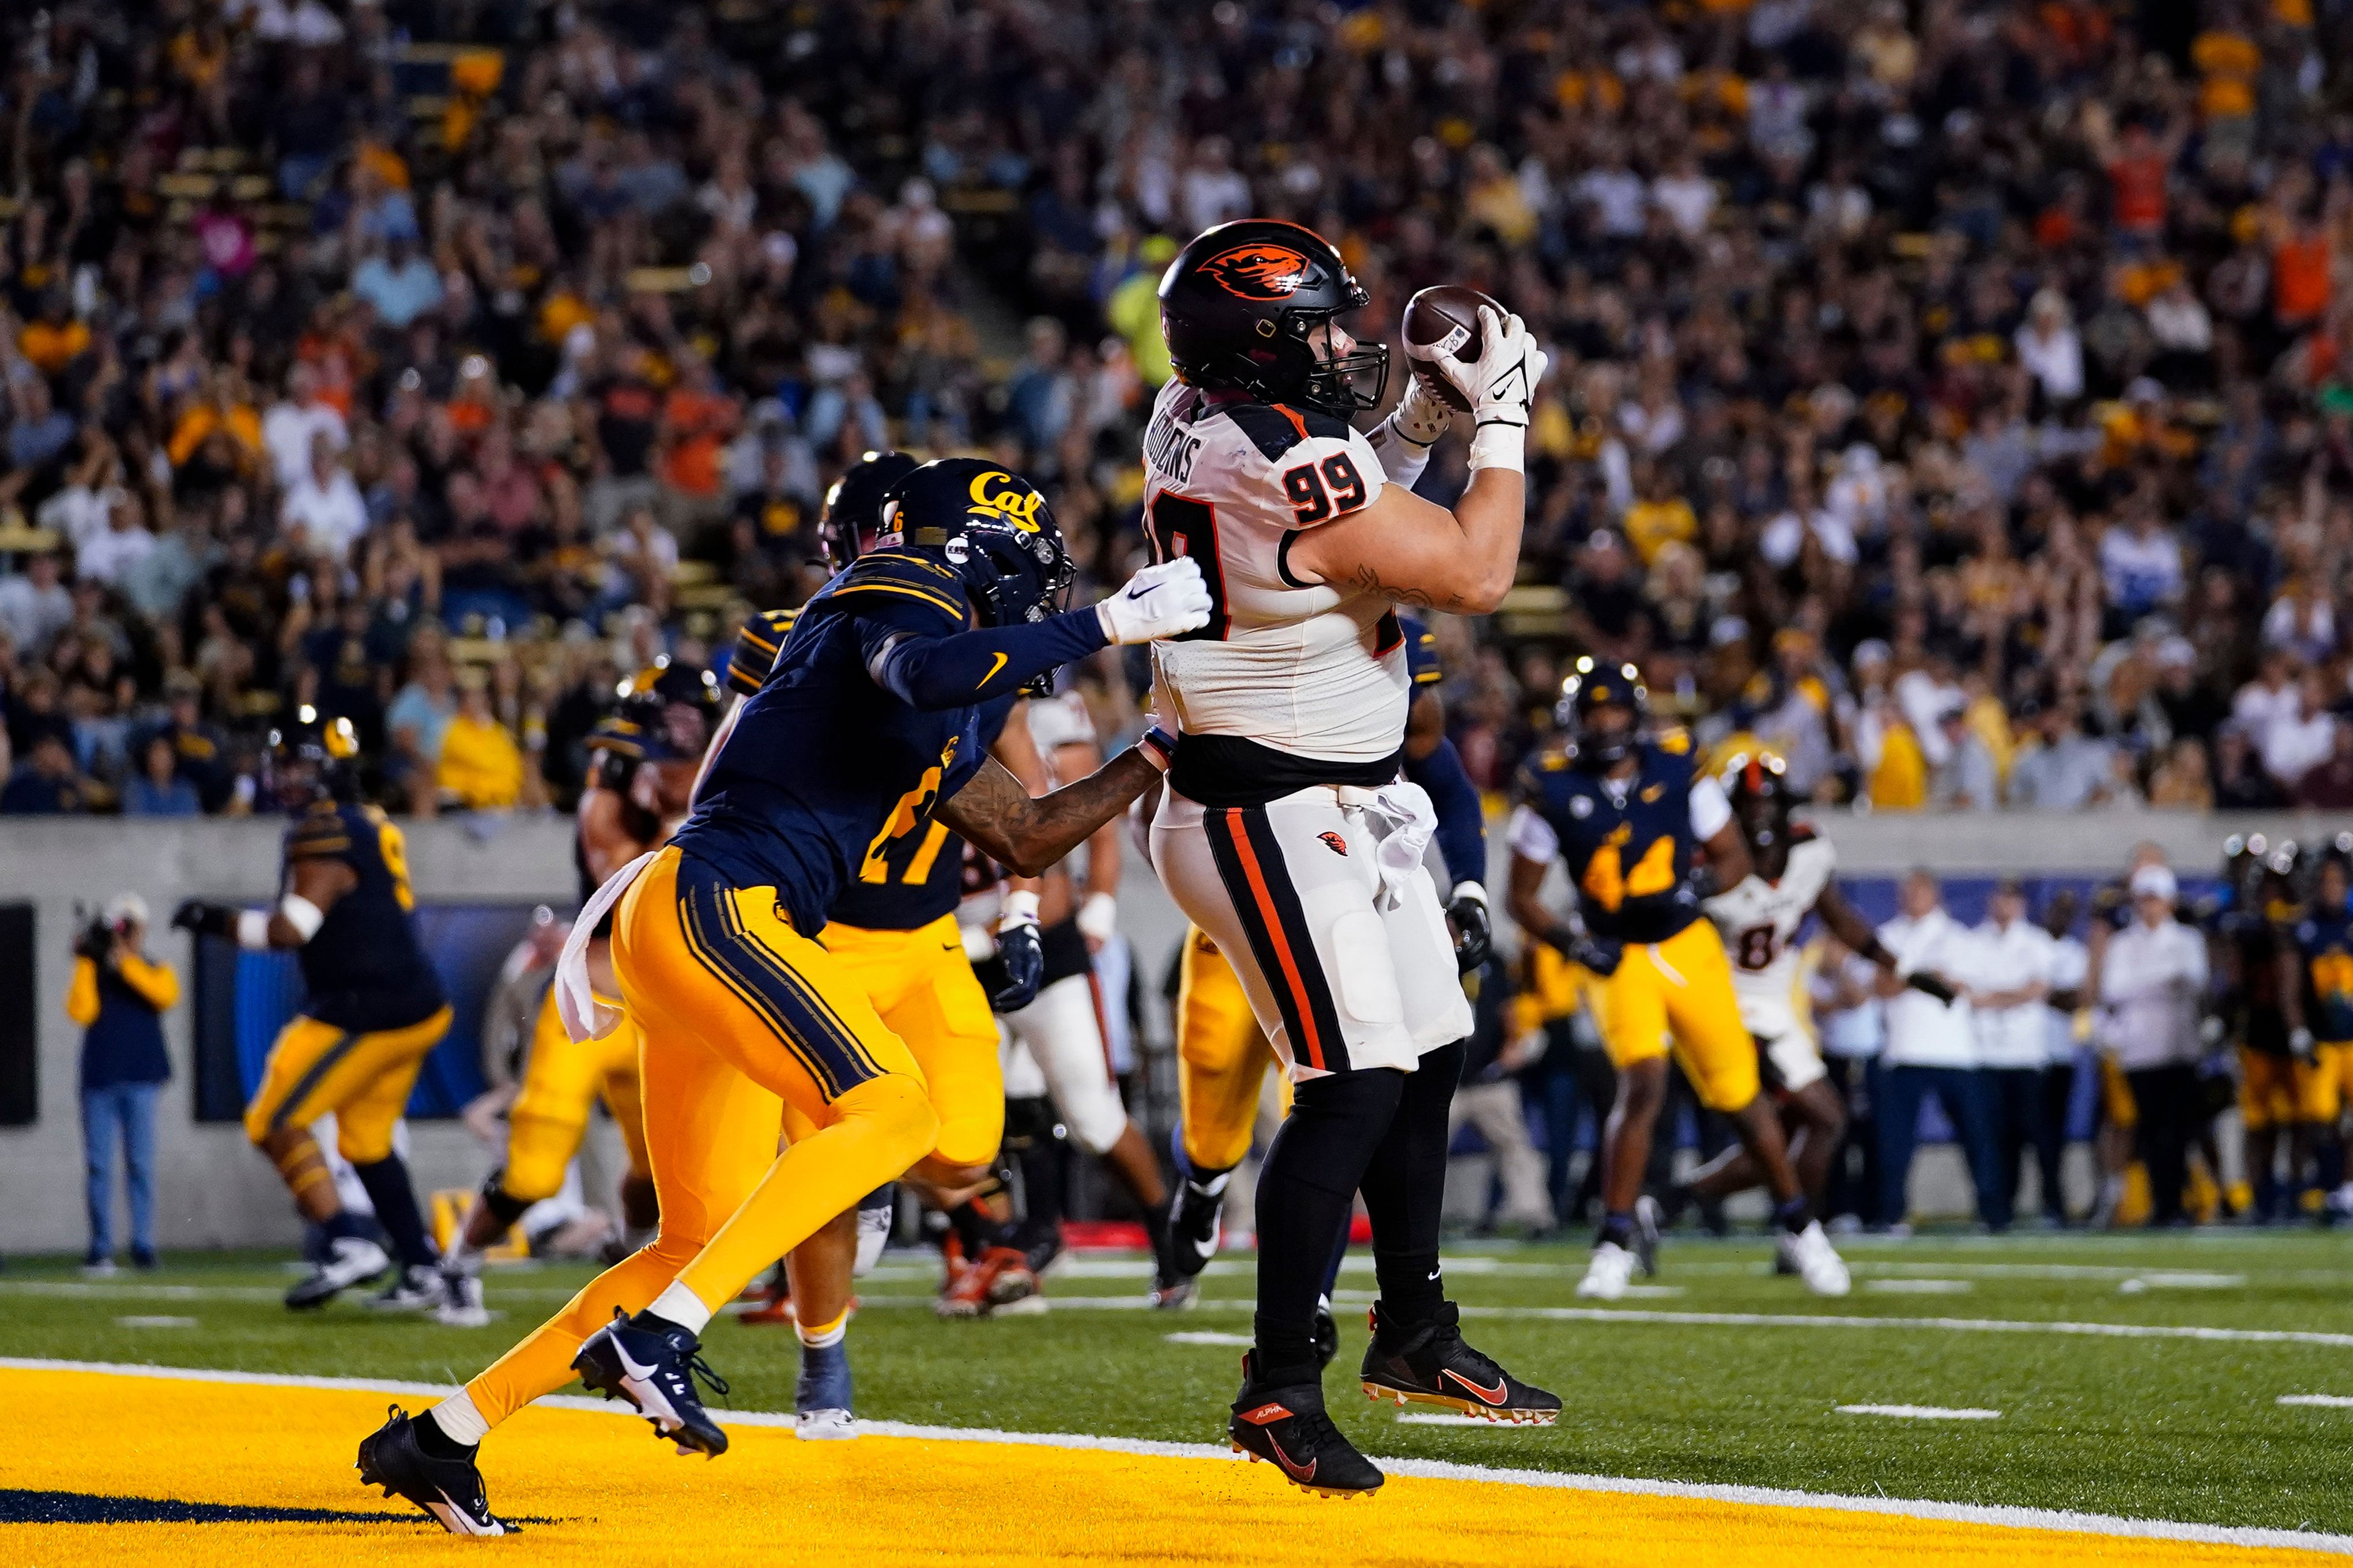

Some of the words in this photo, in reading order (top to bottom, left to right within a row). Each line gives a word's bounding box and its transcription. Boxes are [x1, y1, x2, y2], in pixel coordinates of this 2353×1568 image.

[967, 471, 1041, 532] Cal
[1281, 451, 1367, 526] 99
[893, 511, 904, 532] 6
[1739, 922, 1775, 970] 8
[1255, 1405, 1284, 1420] ALPHA
